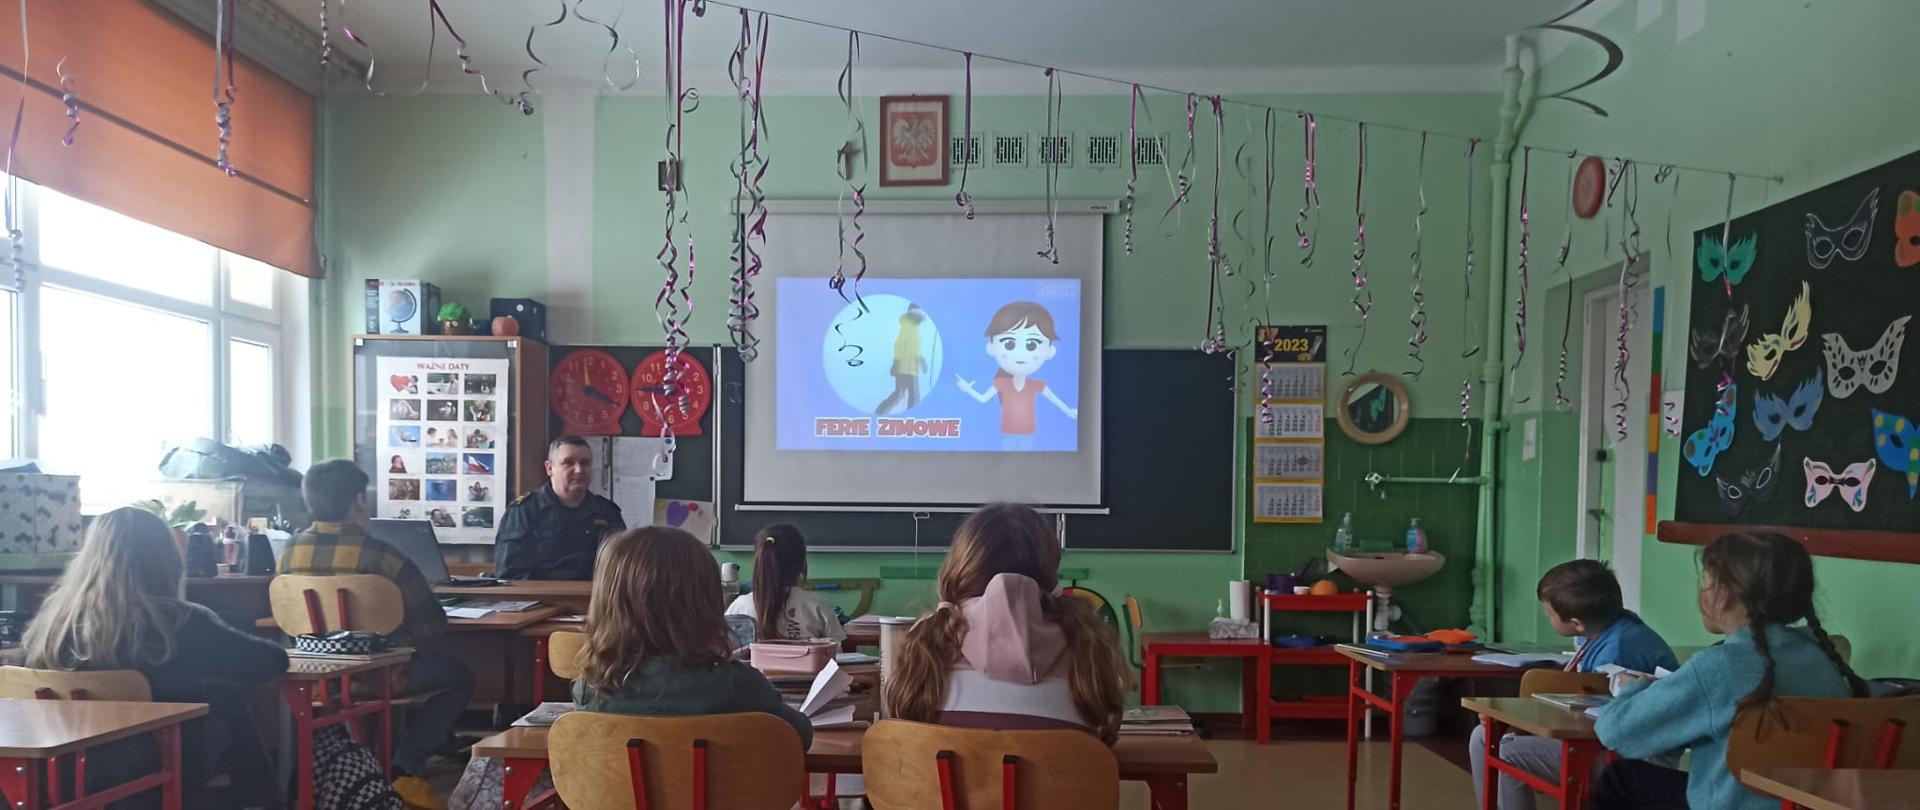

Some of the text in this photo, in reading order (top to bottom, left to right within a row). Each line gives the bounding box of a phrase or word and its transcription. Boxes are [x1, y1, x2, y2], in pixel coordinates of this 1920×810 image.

[1274, 338, 1309, 352] 2023
[448, 362, 471, 371] DATY
[650, 362, 661, 372] 11
[641, 373, 653, 383] 10
[693, 372, 700, 381] 2
[615, 383, 622, 394] 3
[696, 385, 704, 394] 3
[692, 400, 699, 409] 4
[668, 414, 675, 424] 6
[815, 417, 961, 438] FERIE ZIMOWE
